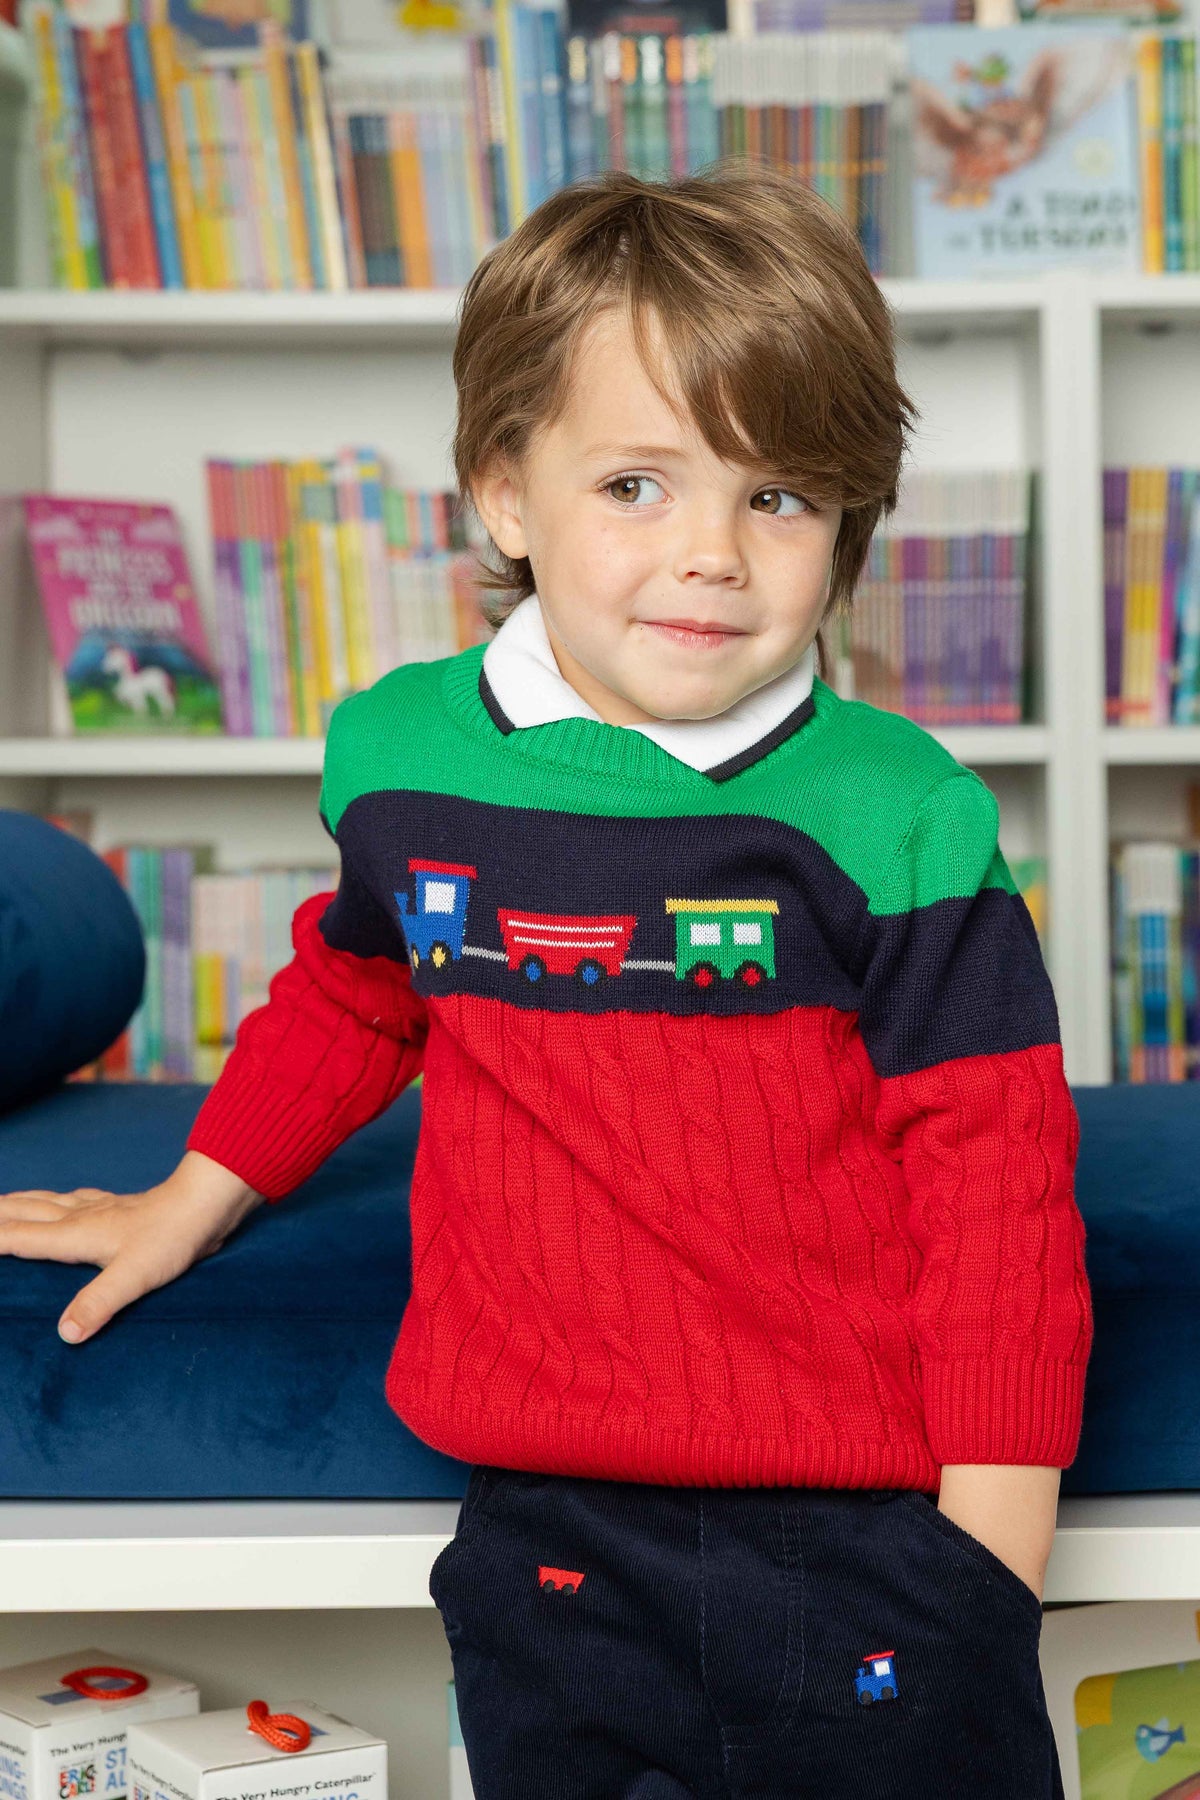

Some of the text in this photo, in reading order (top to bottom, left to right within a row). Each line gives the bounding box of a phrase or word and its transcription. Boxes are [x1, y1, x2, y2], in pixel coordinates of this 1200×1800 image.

[105, 1746, 127, 1769] ST
[105, 1770, 127, 1792] AL
[270, 1785, 311, 1797] Hungry
[314, 1774, 373, 1790] Caterpillar
